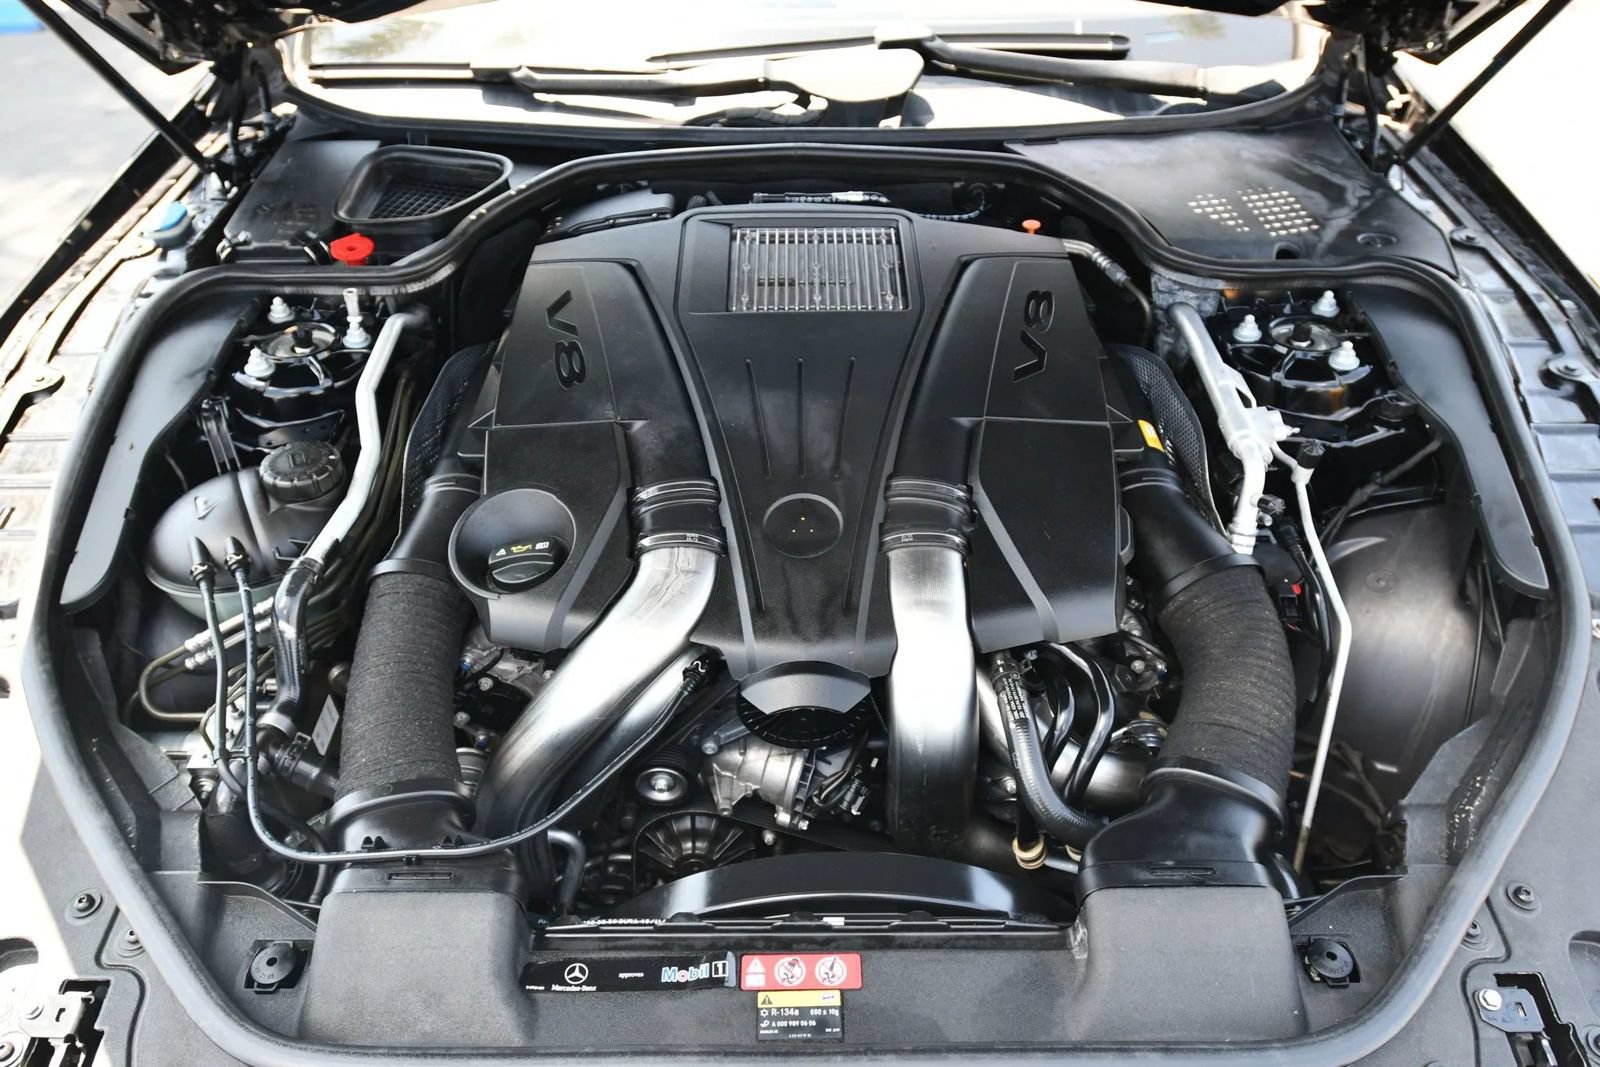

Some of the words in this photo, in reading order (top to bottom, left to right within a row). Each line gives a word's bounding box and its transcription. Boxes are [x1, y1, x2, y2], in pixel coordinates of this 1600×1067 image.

[545, 290, 586, 389] V8
[1012, 289, 1055, 383] V8
[661, 963, 709, 982] Mobil
[712, 961, 728, 977] 1
[551, 984, 597, 992] Mercedes-Benz
[771, 1008, 800, 1016] R-134a
